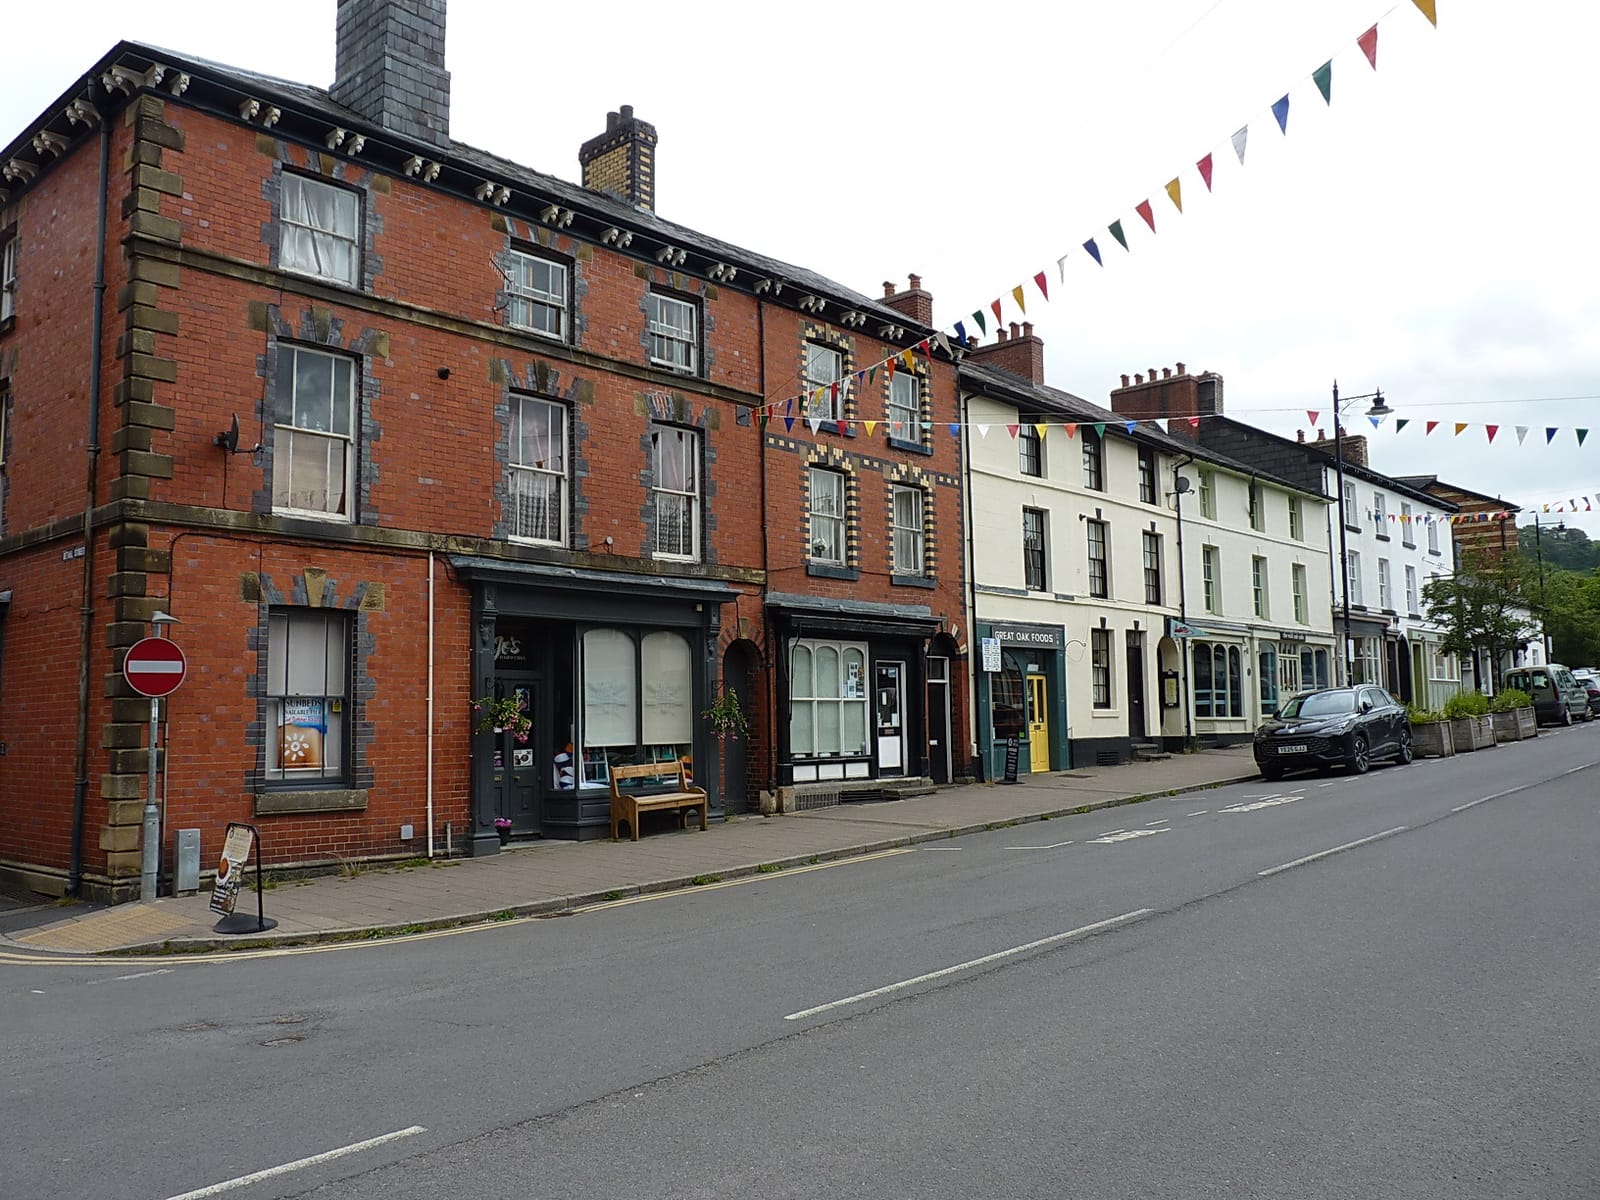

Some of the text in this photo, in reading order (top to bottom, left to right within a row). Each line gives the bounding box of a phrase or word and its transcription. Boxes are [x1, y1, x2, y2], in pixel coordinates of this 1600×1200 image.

[994, 630, 1015, 641] GREAT
[1016, 631, 1031, 642] OAK
[1031, 633, 1054, 643] FOODS
[285, 699, 321, 708] SUNBEDS
